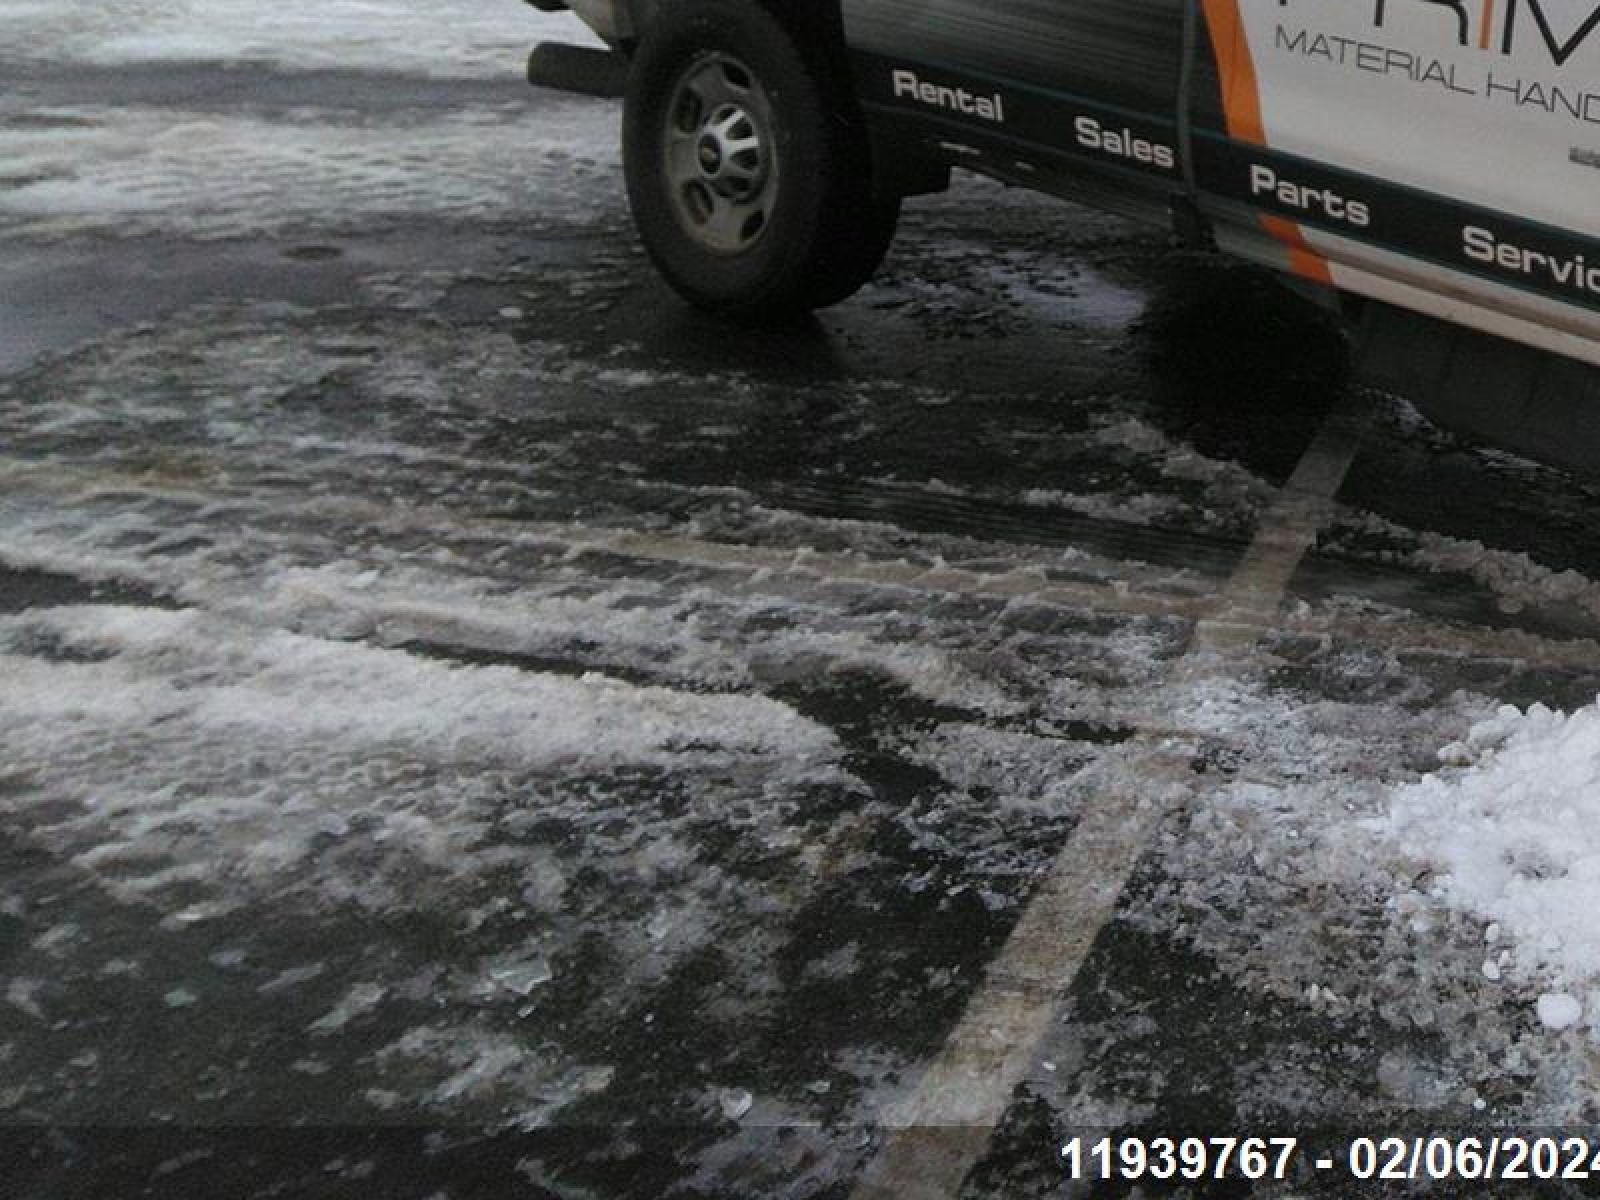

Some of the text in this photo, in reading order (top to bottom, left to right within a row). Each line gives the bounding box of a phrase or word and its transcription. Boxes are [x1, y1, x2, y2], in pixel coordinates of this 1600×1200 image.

[1274, 24, 1477, 95] MATERIAL
[893, 68, 1004, 123] Rental
[1074, 115, 1175, 169] Sales
[1250, 163, 1370, 227] Parts
